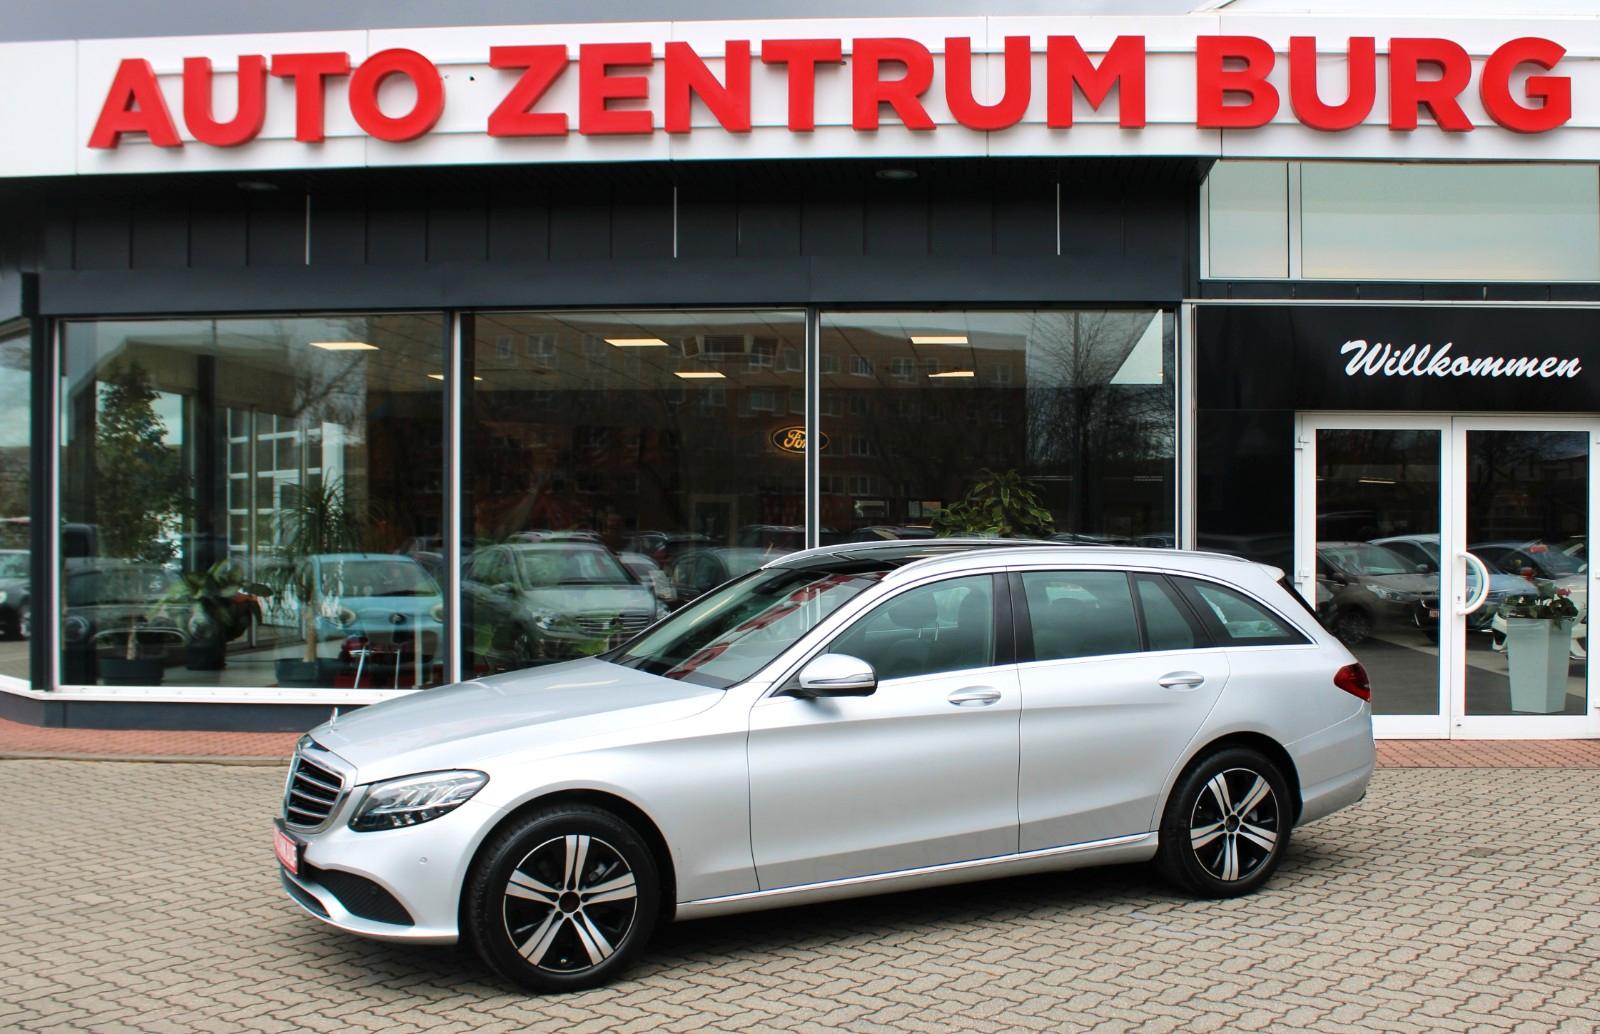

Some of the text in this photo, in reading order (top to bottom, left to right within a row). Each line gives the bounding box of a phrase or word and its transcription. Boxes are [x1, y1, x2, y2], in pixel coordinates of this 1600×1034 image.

[88, 35, 1572, 148] AUTO ZENTRUM BURG
[1340, 339, 1582, 378] Willkommen
